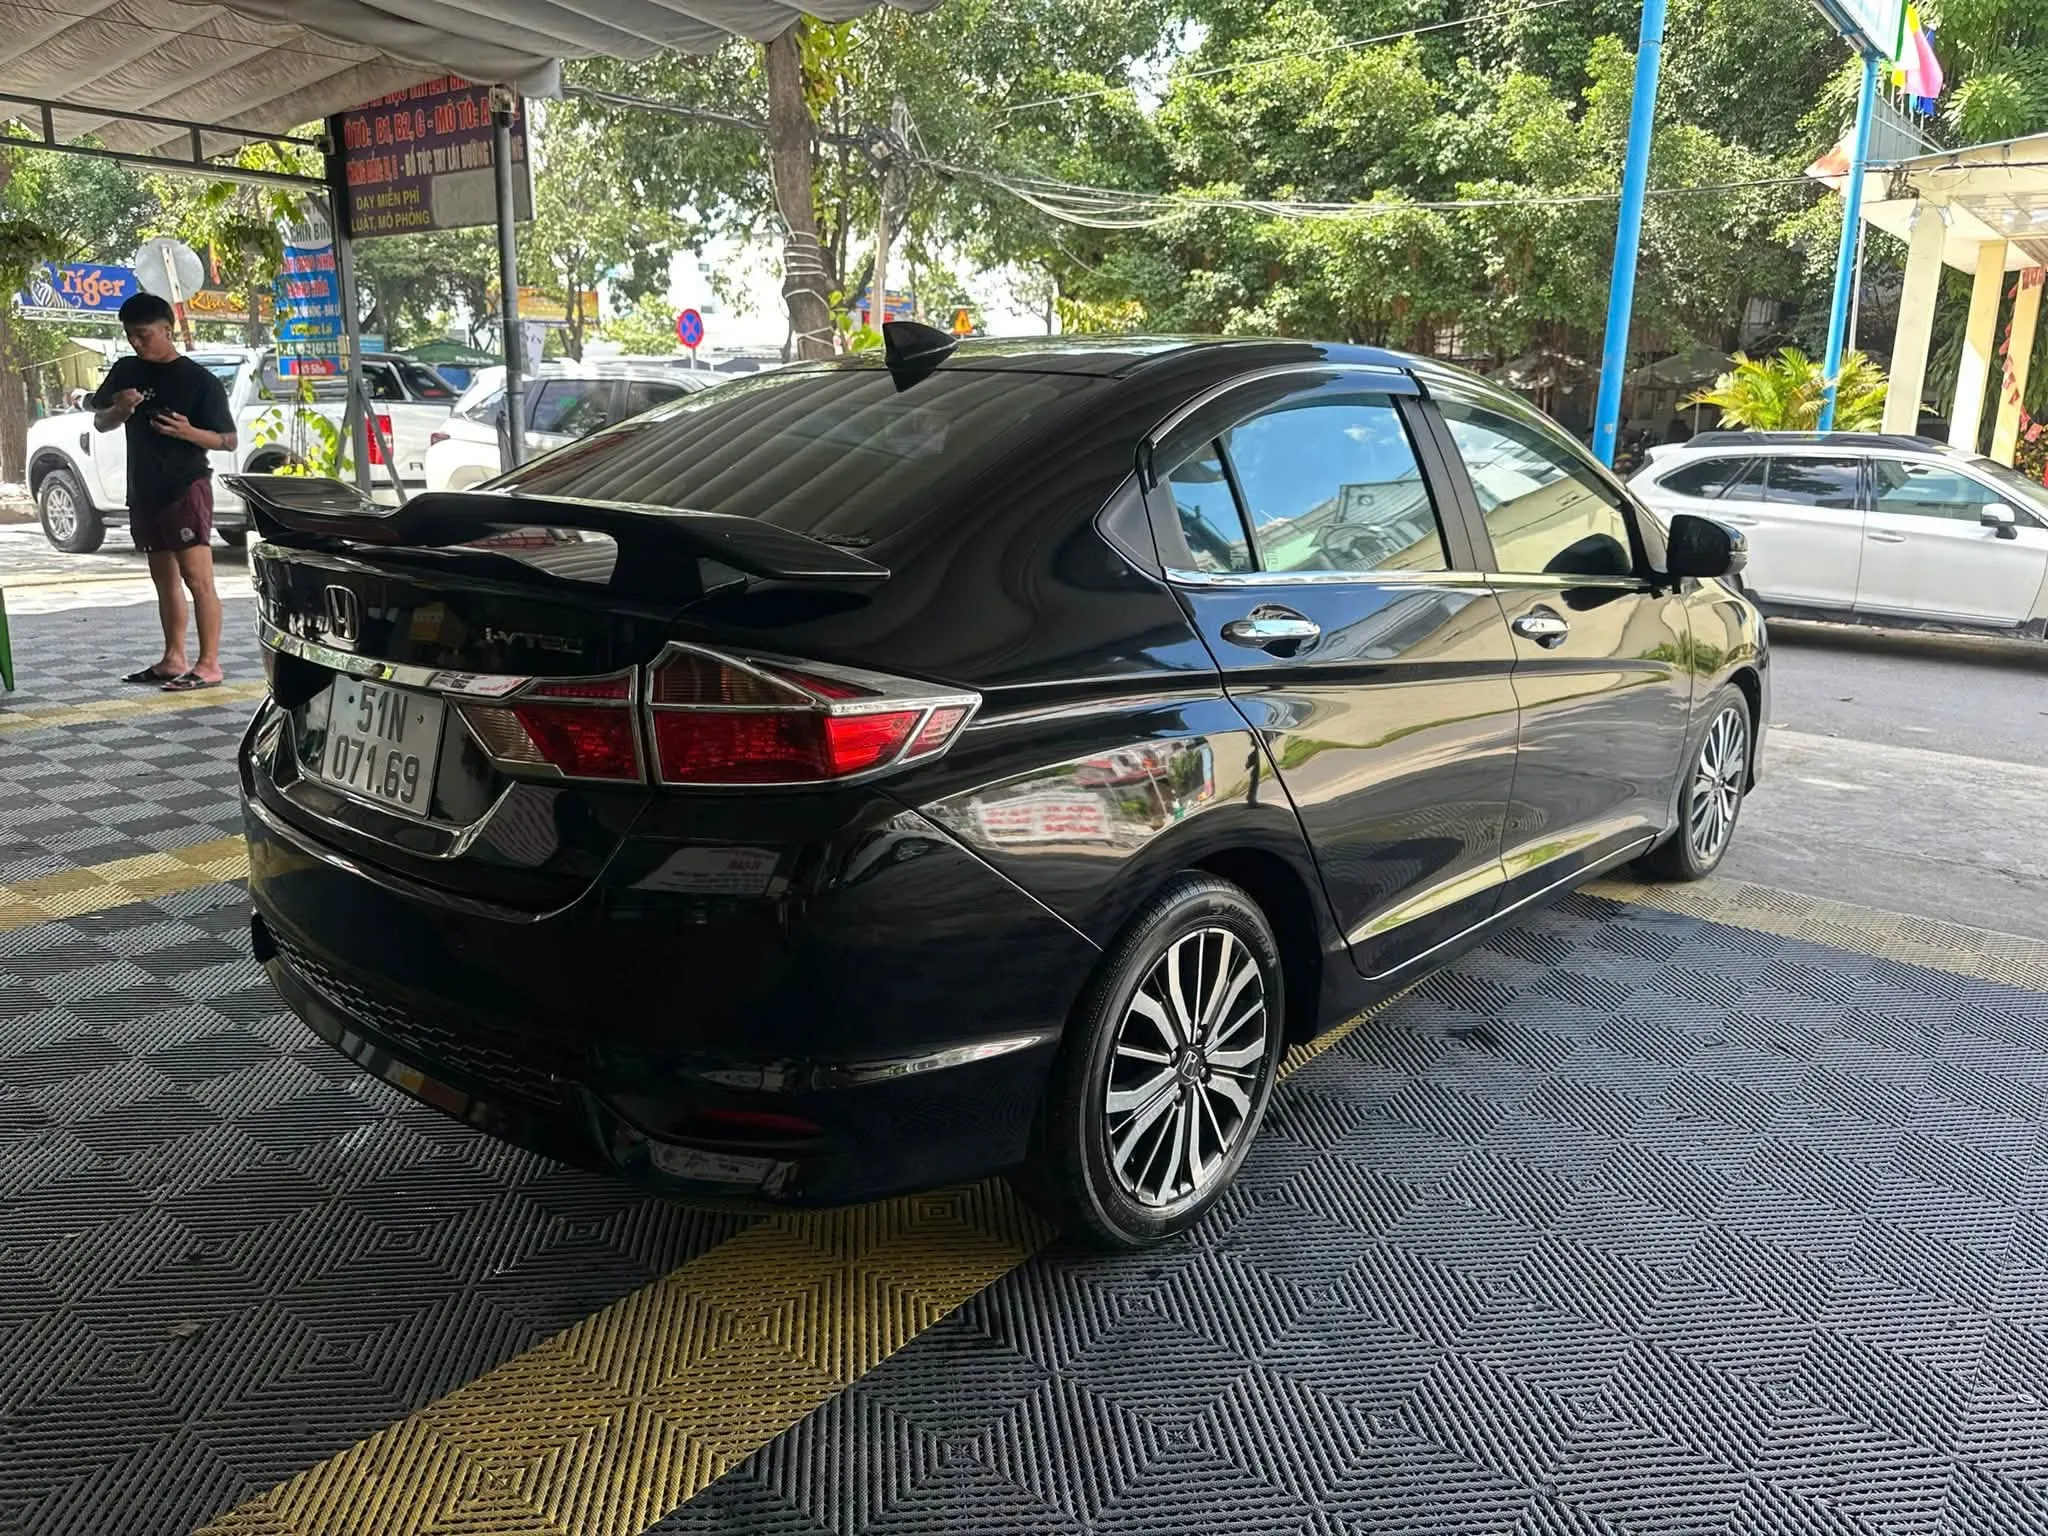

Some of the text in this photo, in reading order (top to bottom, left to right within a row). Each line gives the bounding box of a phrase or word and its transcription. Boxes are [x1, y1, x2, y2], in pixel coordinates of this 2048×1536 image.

[394, 112, 415, 141] B2,
[403, 185, 420, 205] PHÍ
[62, 269, 126, 306] Tiger
[357, 685, 408, 743] 51N
[332, 735, 420, 804] 071.69
